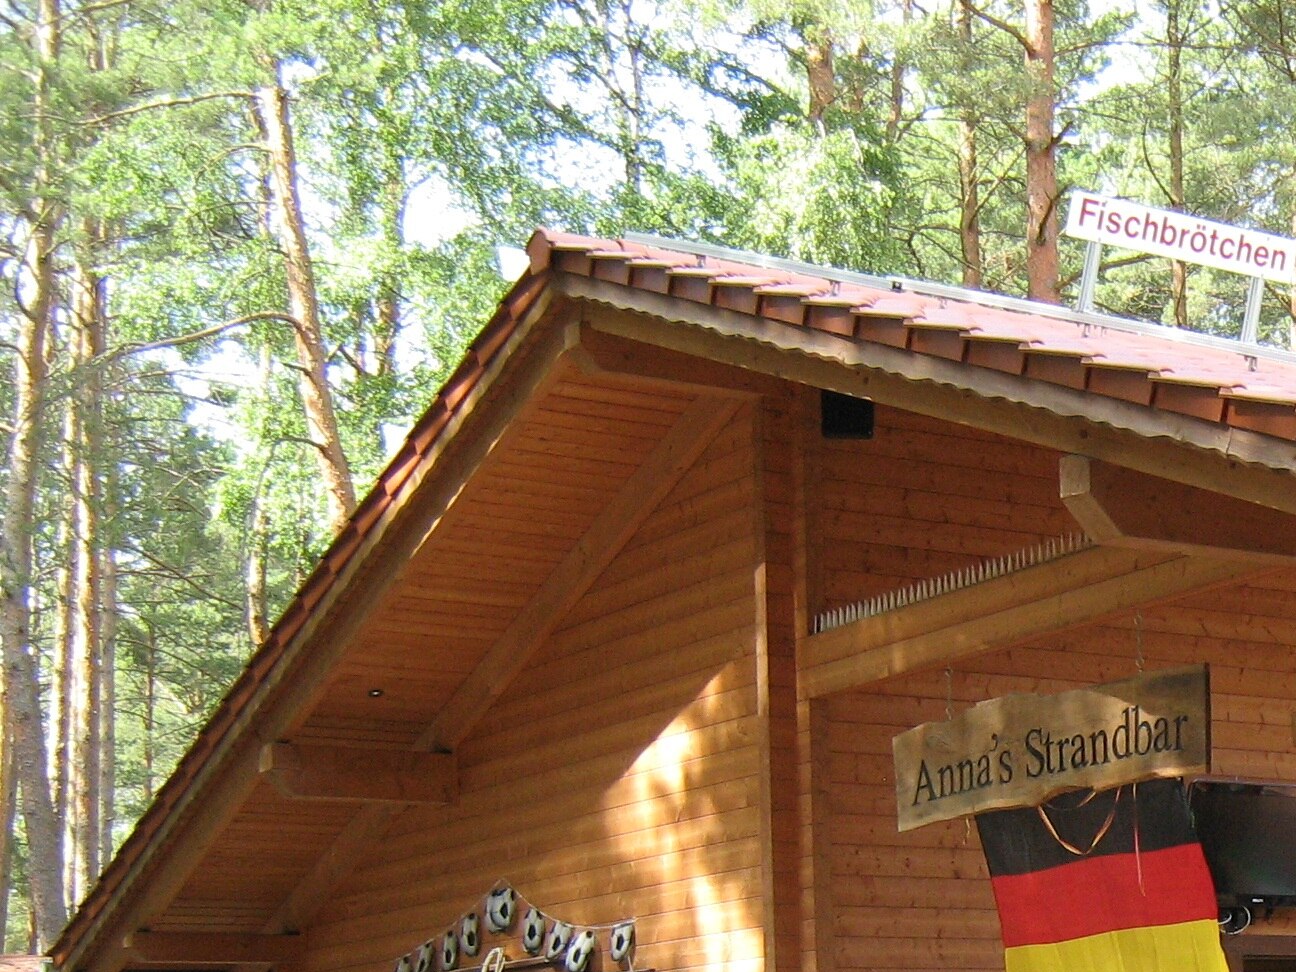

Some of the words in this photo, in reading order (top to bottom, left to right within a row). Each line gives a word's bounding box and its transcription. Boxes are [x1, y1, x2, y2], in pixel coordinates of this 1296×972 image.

[1078, 199, 1287, 272] Fischbrötchen
[911, 732, 1014, 806] Anna's
[1024, 705, 1189, 779] Strandbar
